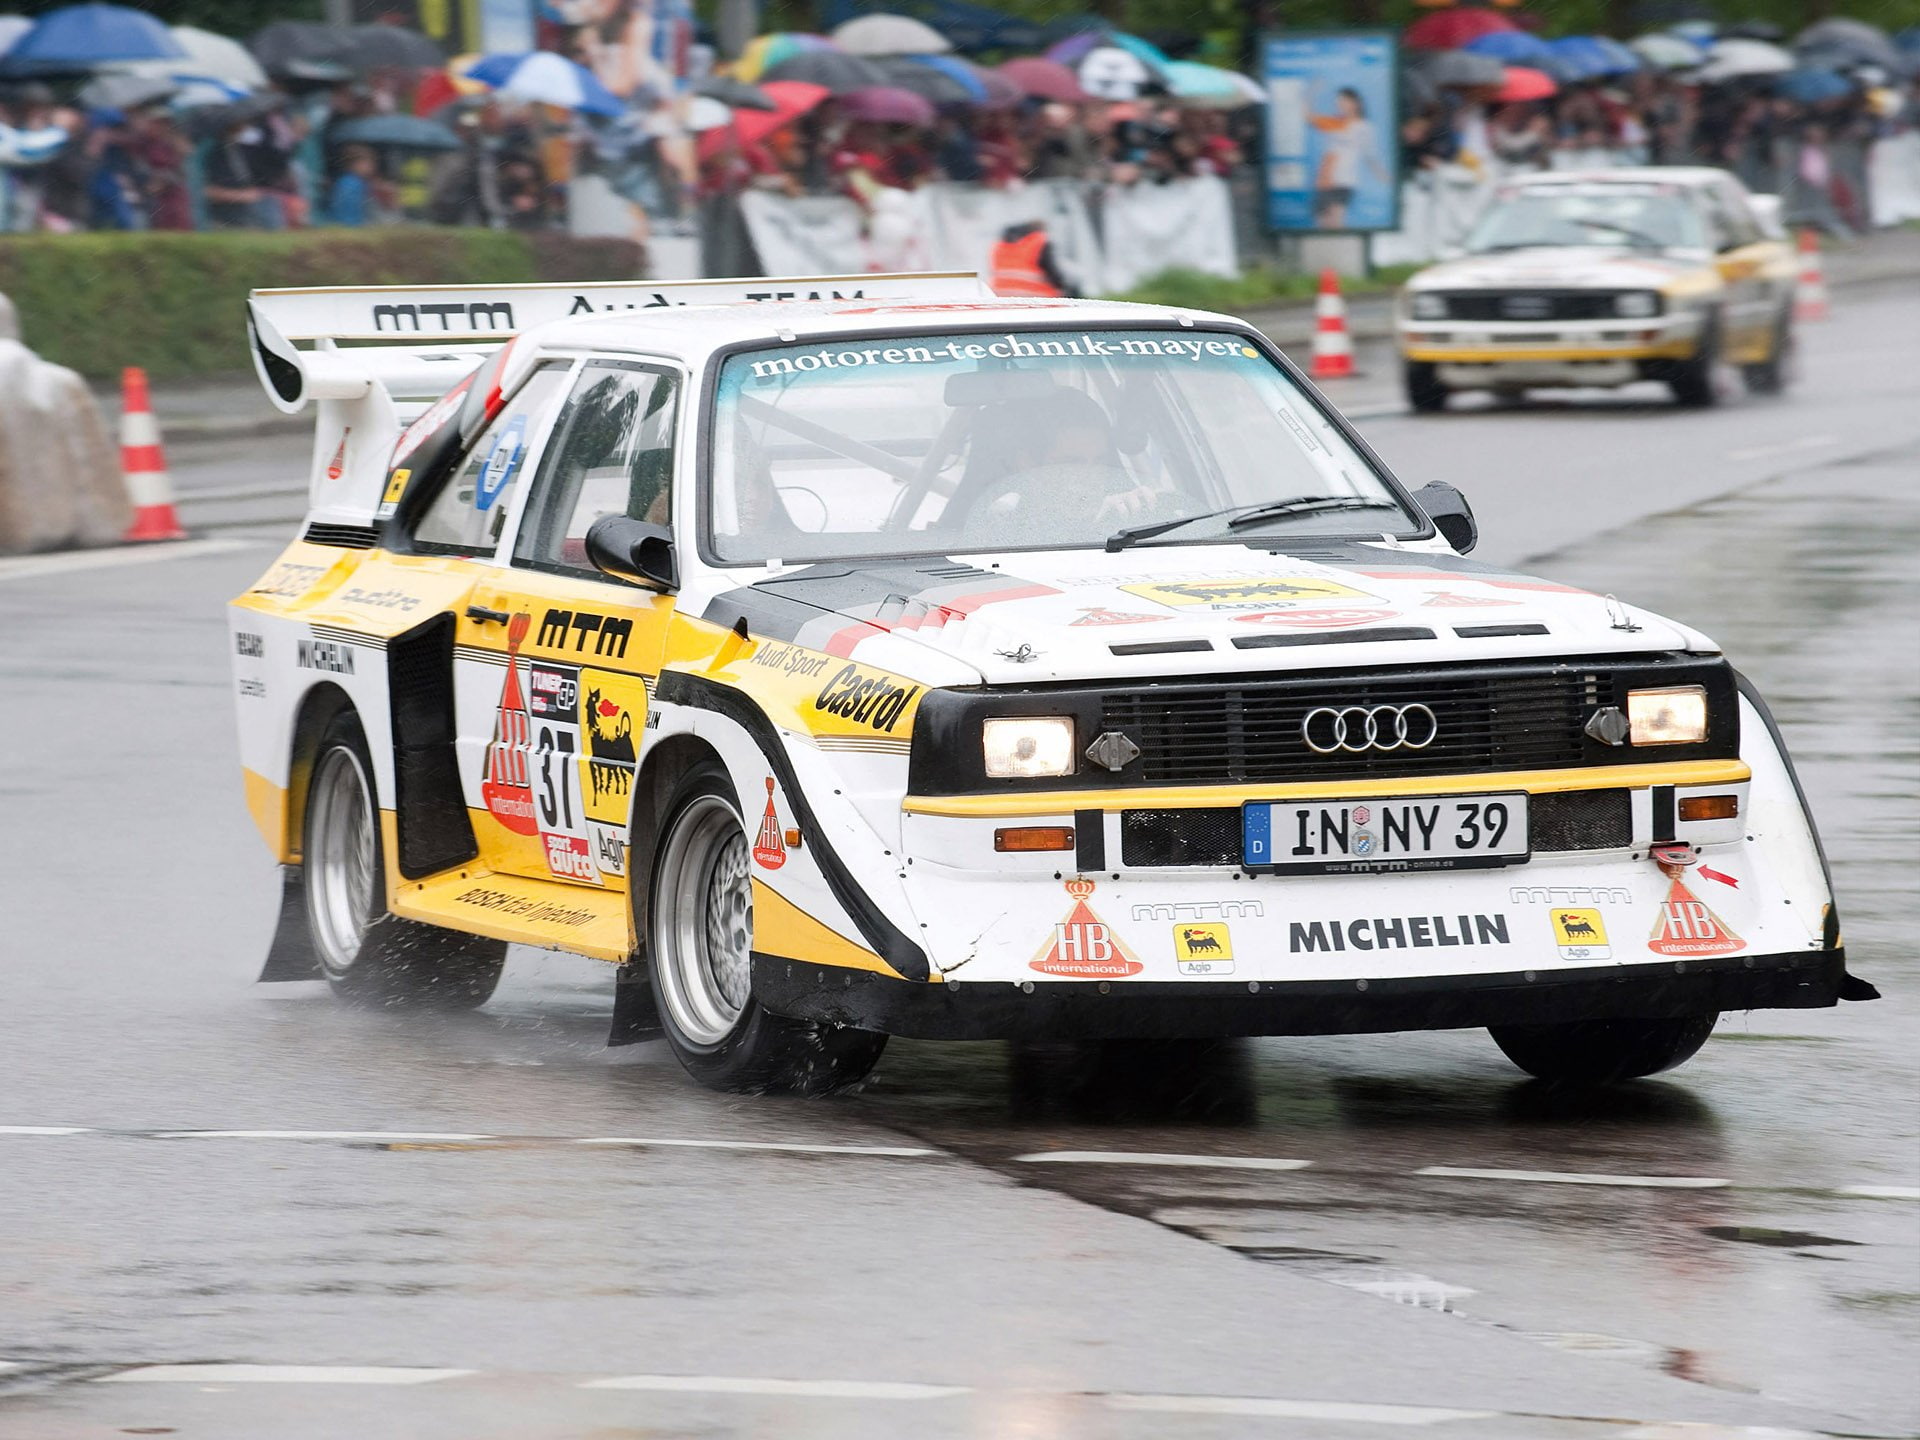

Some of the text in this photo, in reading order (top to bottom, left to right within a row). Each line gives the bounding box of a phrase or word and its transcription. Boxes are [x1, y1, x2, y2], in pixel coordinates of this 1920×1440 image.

[297, 640, 355, 675] MICHELIN
[751, 643, 829, 677] Audi Sport
[532, 670, 562, 694] TUNER
[816, 664, 919, 733] Castrol
[539, 727, 574, 829] 37
[547, 835, 572, 850] sport
[762, 815, 778, 850] HB
[1292, 803, 1508, 856] IN NY 39
[1252, 840, 1263, 853] D
[549, 849, 594, 878] auto
[455, 888, 511, 909] BOSCH
[1289, 914, 1510, 953] MICHELIN
[1660, 901, 1716, 939] HB
[1056, 923, 1112, 961] HB
[1568, 947, 1589, 958] Agip
[1661, 941, 1736, 953] international
[1043, 963, 1129, 975] international
[1187, 963, 1212, 973] Agip
